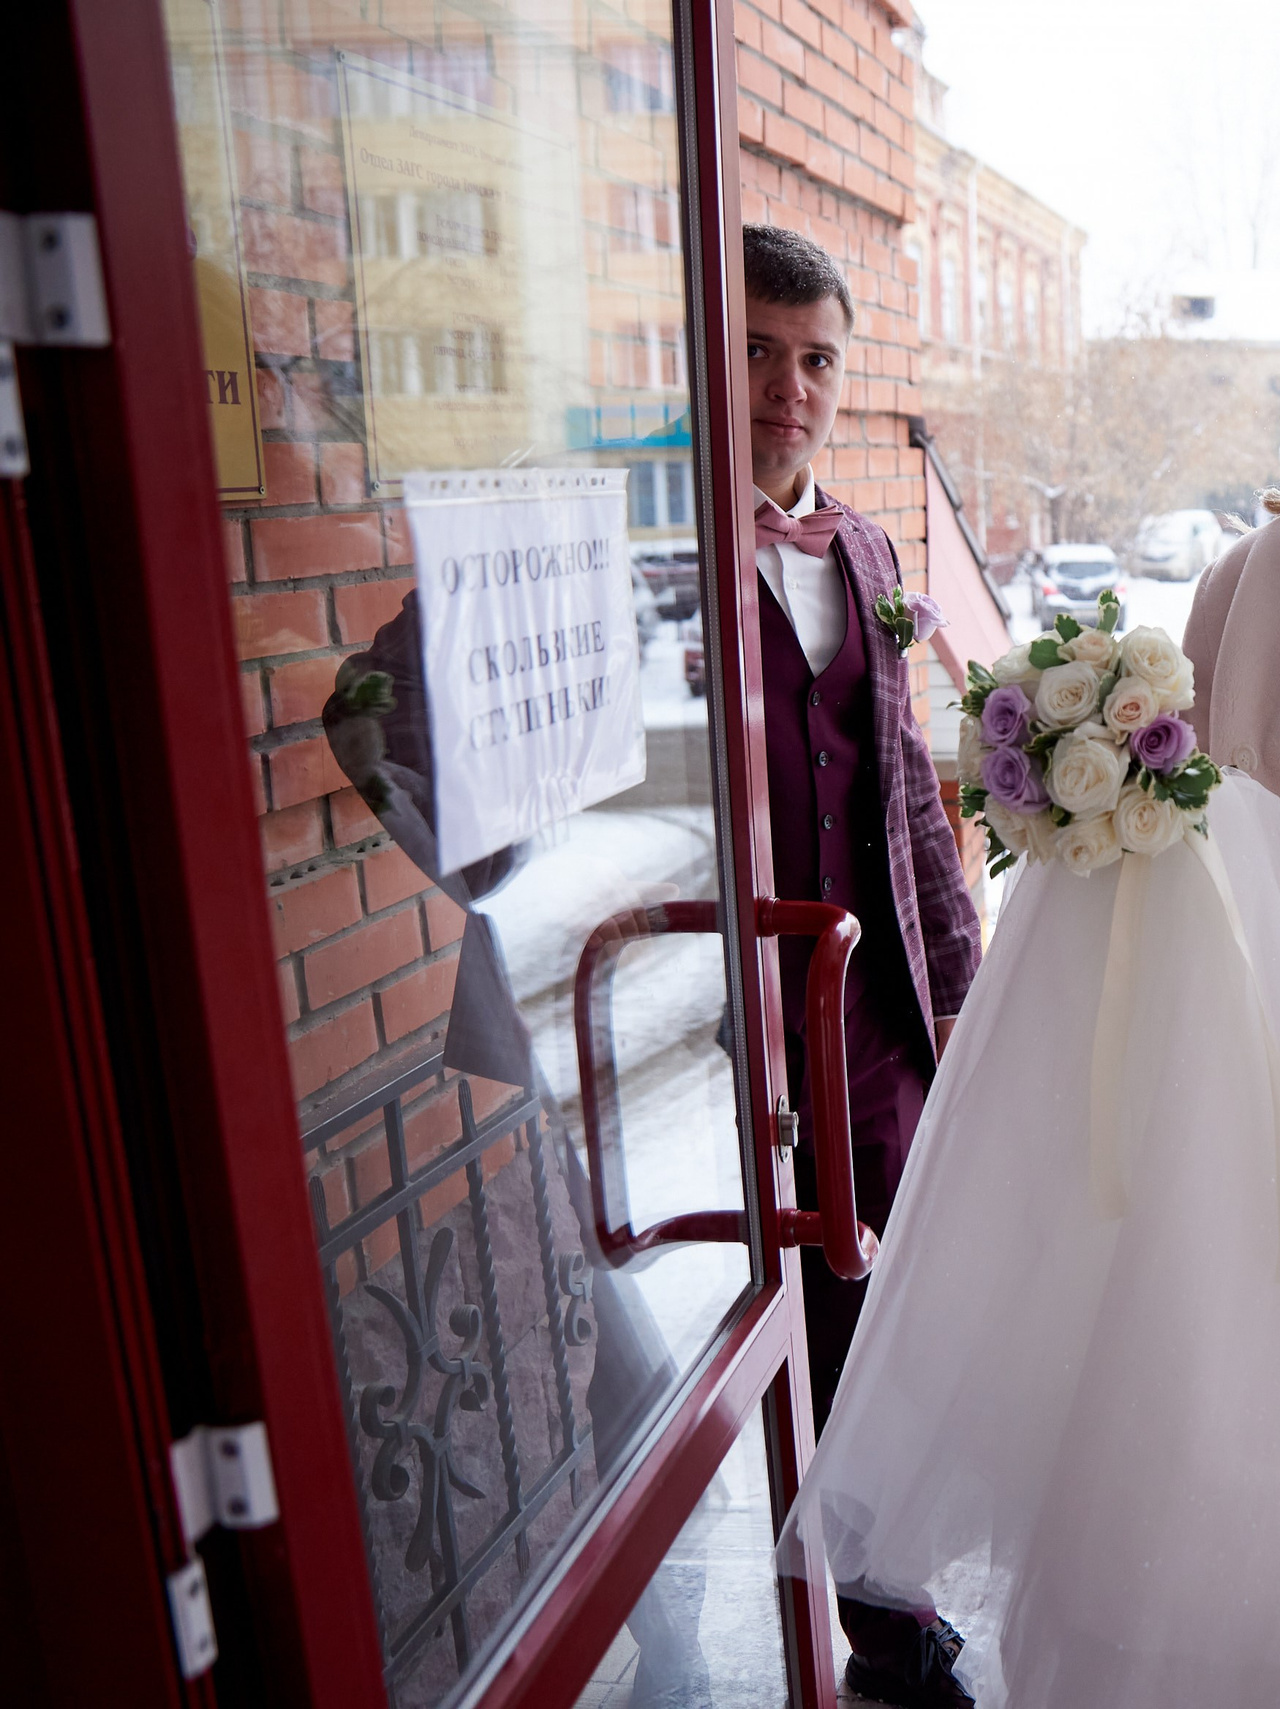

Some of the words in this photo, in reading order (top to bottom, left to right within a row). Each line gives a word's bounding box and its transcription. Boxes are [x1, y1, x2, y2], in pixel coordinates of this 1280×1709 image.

[359, 147, 393, 172] Отдел
[396, 157, 423, 180] ЗАГС
[425, 169, 460, 193] города
[441, 537, 610, 595] ОСТОРОЖНО!!!
